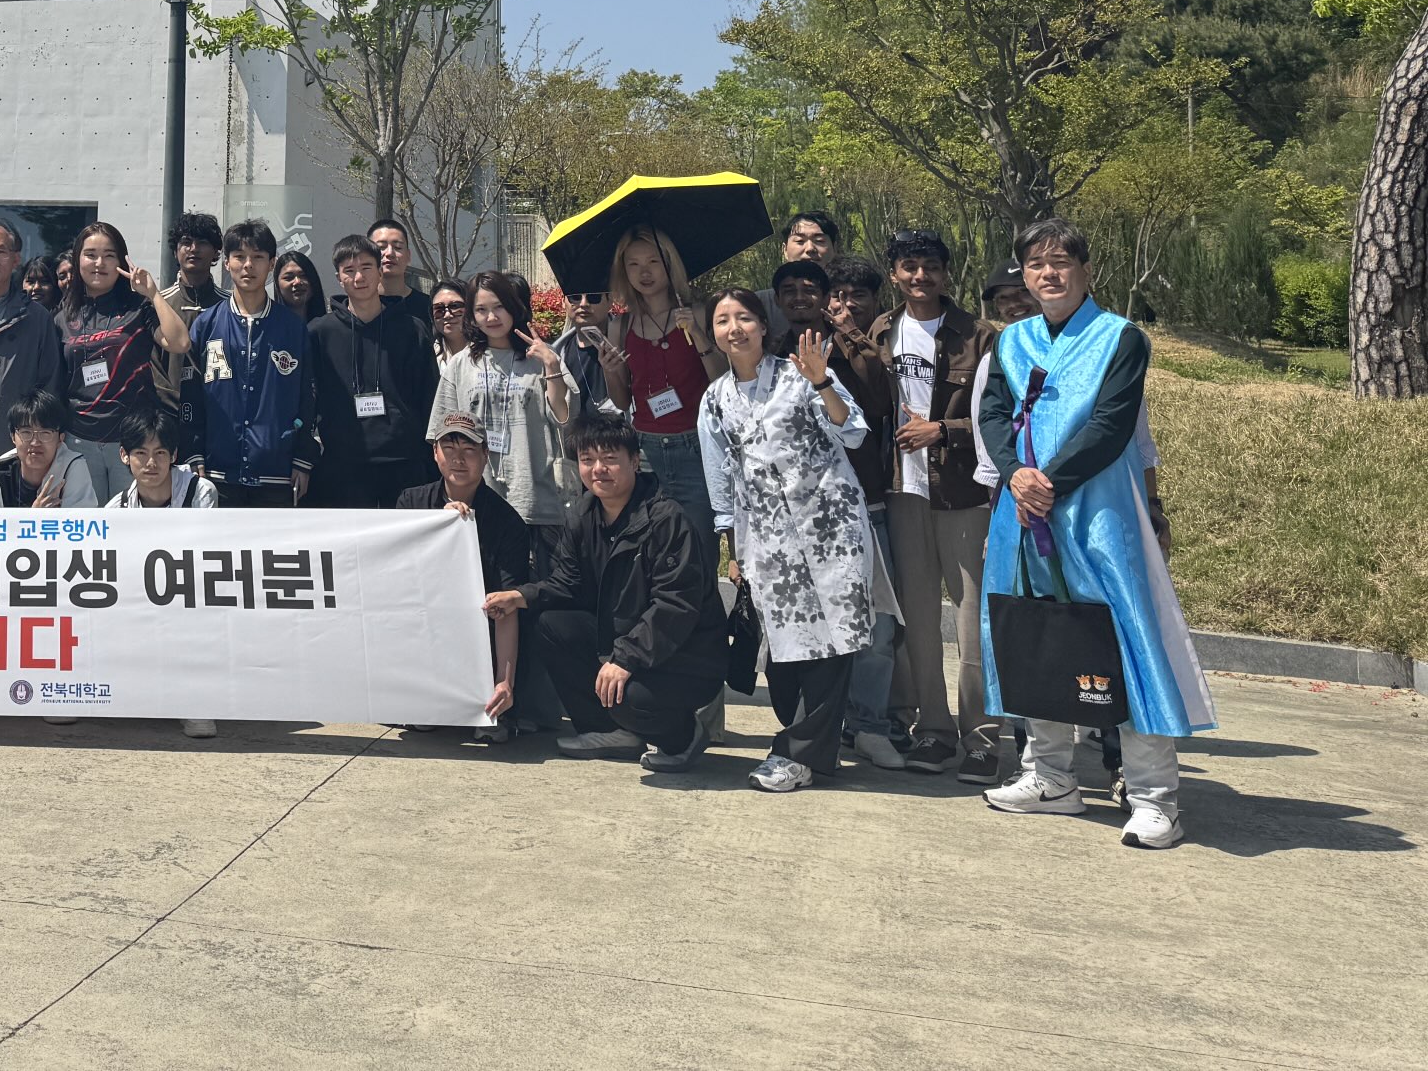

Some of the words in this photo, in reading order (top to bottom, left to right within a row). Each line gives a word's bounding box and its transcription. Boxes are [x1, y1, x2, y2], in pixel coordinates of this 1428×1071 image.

[204, 338, 233, 384] A
[900, 355, 922, 366] VANS
[917, 366, 934, 378] WAL
[18, 518, 109, 543] 교류행사
[143, 549, 337, 610] 여러분!
[40, 682, 112, 698] 전북대학교
